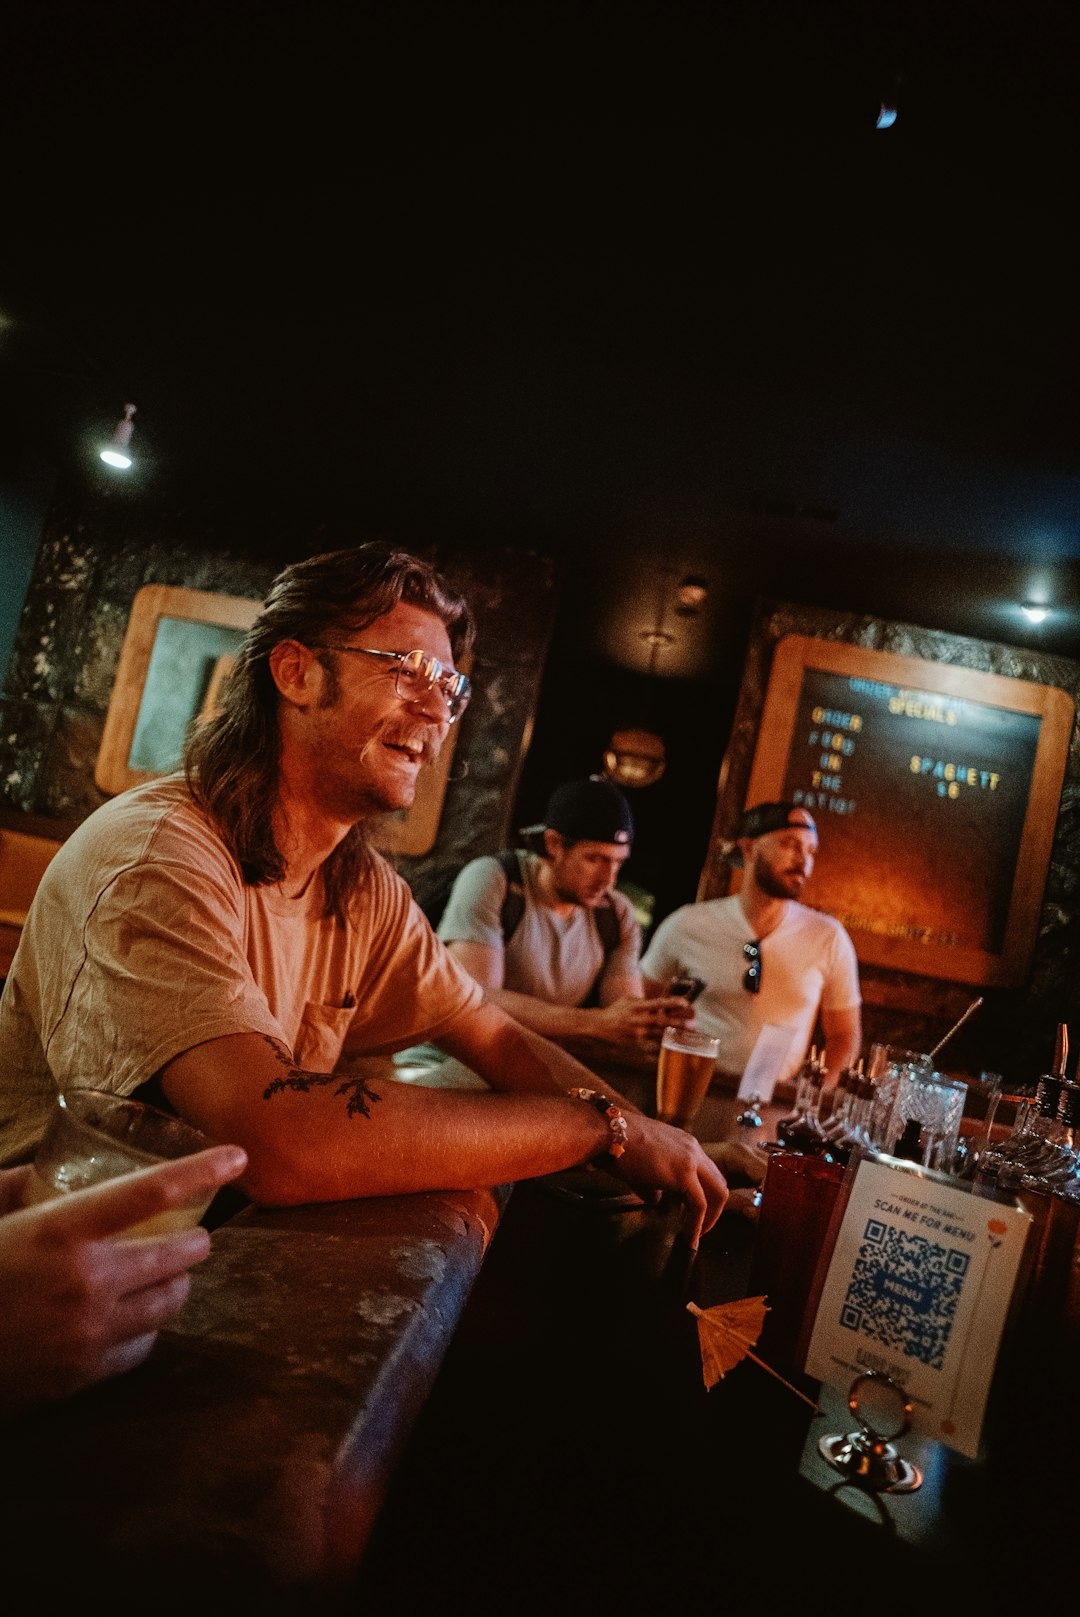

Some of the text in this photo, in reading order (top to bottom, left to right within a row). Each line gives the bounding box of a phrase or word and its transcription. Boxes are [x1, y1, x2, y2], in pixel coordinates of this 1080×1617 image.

[808, 730, 855, 757] FOOD
[812, 769, 842, 793] THE
[910, 755, 1000, 791] SPAGHETT
[873, 1198, 977, 1242] SCAN ME FOR MENU
[882, 1278, 924, 1302] MENU
